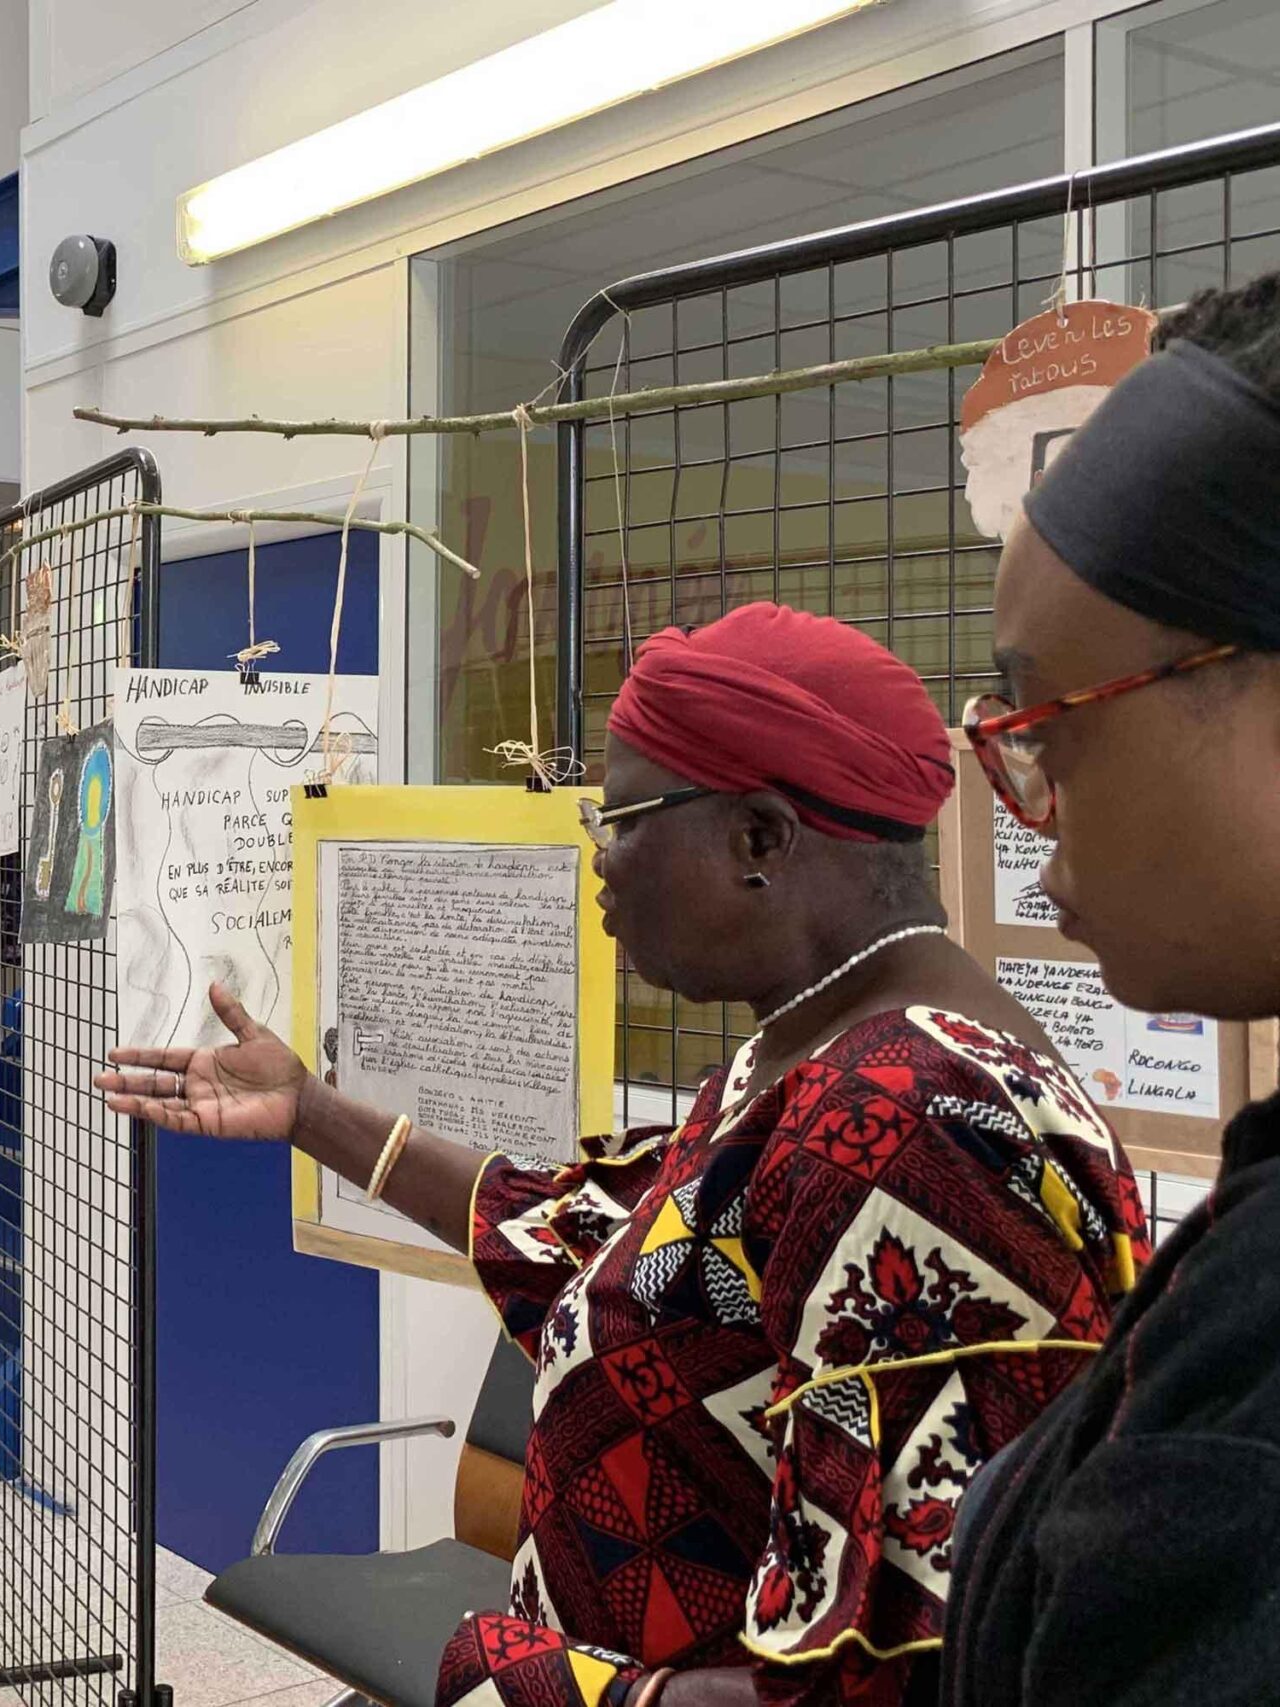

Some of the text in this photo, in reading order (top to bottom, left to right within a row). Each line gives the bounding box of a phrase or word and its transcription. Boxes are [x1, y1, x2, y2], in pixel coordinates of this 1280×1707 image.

[126, 675, 208, 703] HANDICAP
[161, 790, 241, 809] HANDICAP
[224, 814, 267, 831] PARCE
[168, 863, 181, 881] EN
[187, 862, 208, 877] PLUS
[259, 860, 293, 874] ENCOR
[168, 887, 188, 903] QUE
[195, 884, 208, 898] SA
[211, 908, 291, 935] SOCIALEM
